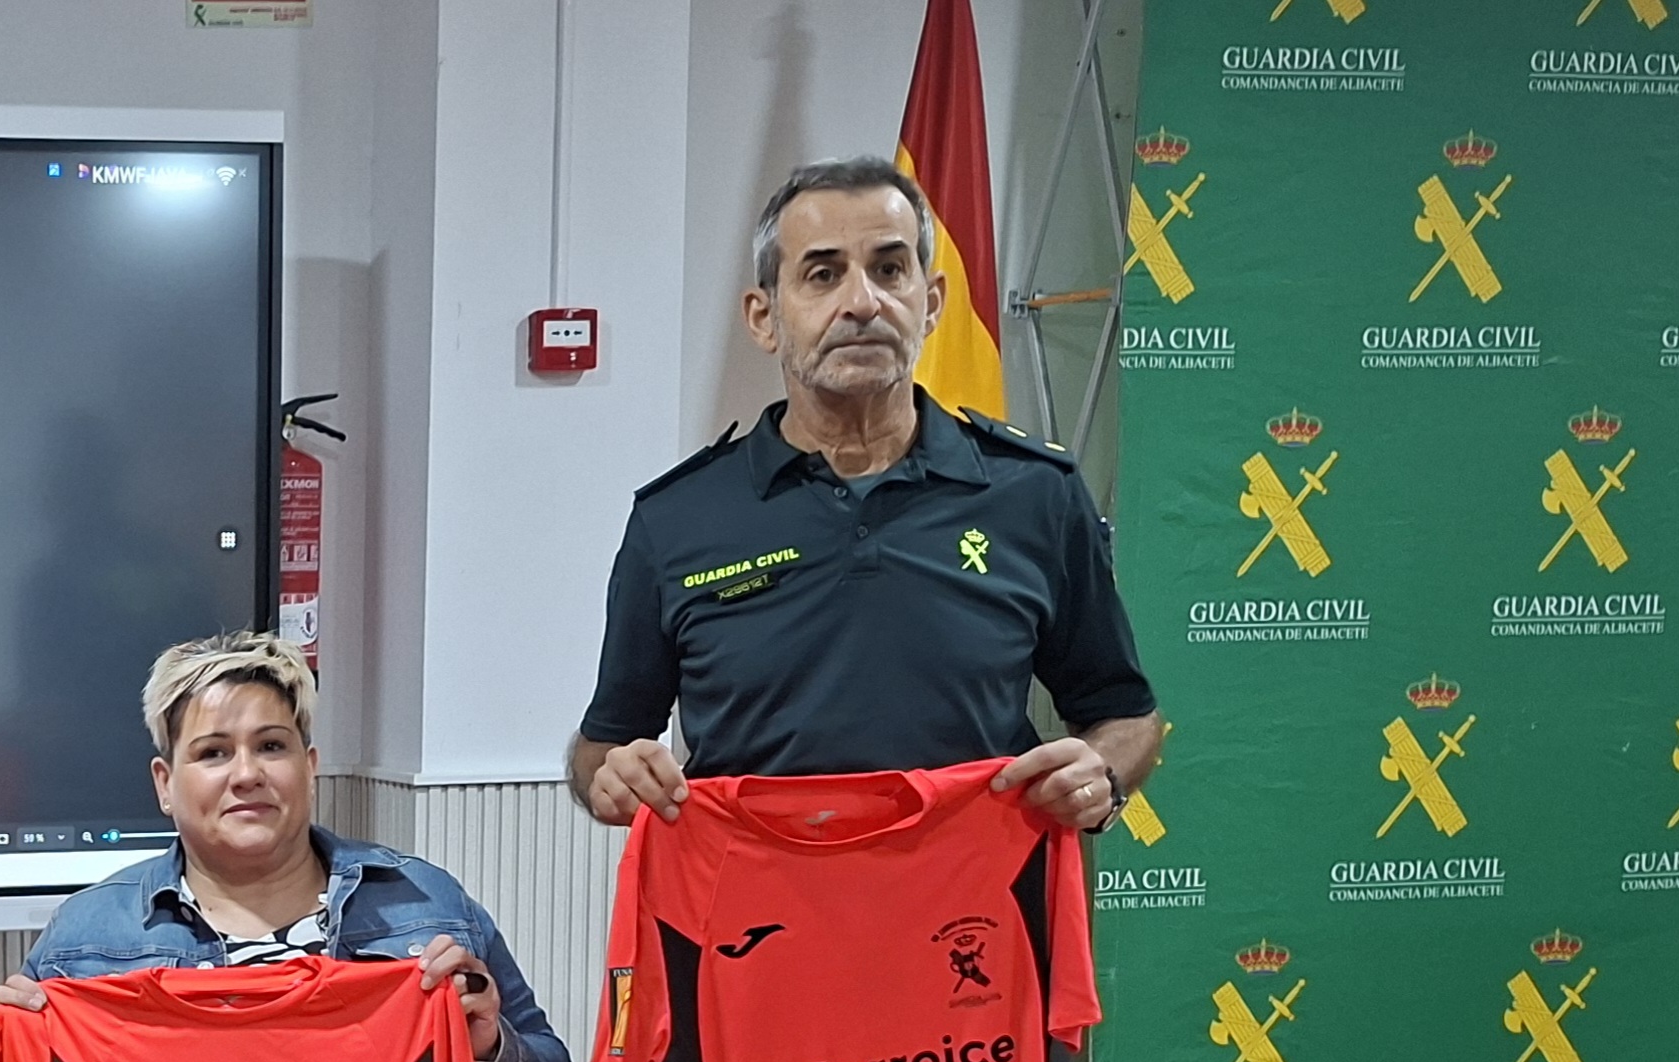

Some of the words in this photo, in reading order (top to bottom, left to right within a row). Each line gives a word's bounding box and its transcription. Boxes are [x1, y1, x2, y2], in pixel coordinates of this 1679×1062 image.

[1222, 46, 1333, 70] GUARDIA
[1341, 47, 1406, 71] CIVIL
[1529, 50, 1638, 75] GUARDIA
[1643, 53, 1679, 76] CIV
[1221, 75, 1318, 91] COMANDANCIA
[1320, 76, 1337, 91] DE
[1337, 77, 1405, 92] ALBACETE
[1528, 78, 1622, 94] COMANDANCIA
[1623, 80, 1640, 95] DE
[1641, 80, 1679, 95] ALBAC
[1169, 327, 1236, 350] CIVIL
[1362, 327, 1472, 349] GUARDIA
[1477, 326, 1541, 349] CIVIL
[1149, 355, 1166, 369] DE
[1168, 356, 1235, 369] ALBACETE
[1361, 354, 1455, 369] COMANDANCIA
[1456, 354, 1474, 368] DE
[1474, 353, 1541, 368] ALBACETE
[683, 560, 752, 588] GUARDIA
[755, 547, 800, 569] CIVIL
[1189, 601, 1302, 624] GUARDIA
[1306, 599, 1371, 622] CIVIL
[1492, 596, 1600, 619] GUARDIA
[1604, 594, 1666, 617] CIVIL
[1187, 627, 1284, 643] COMANDANCIA
[1286, 627, 1302, 642] DE
[1302, 626, 1369, 641] ALBACETE
[1491, 622, 1583, 637] COMANDANCIA
[1584, 621, 1600, 636] DE
[1601, 620, 1664, 635] ALBACETE
[1141, 867, 1207, 890] CIVIL
[1330, 861, 1440, 885] GUARDIA
[1443, 858, 1506, 881] CIVIL
[1121, 896, 1139, 910] DE
[1140, 894, 1206, 909] ALBACETE
[1329, 887, 1421, 902] COMANDANCIA
[1422, 885, 1440, 900] DE
[1440, 883, 1504, 899] ALBACETE
